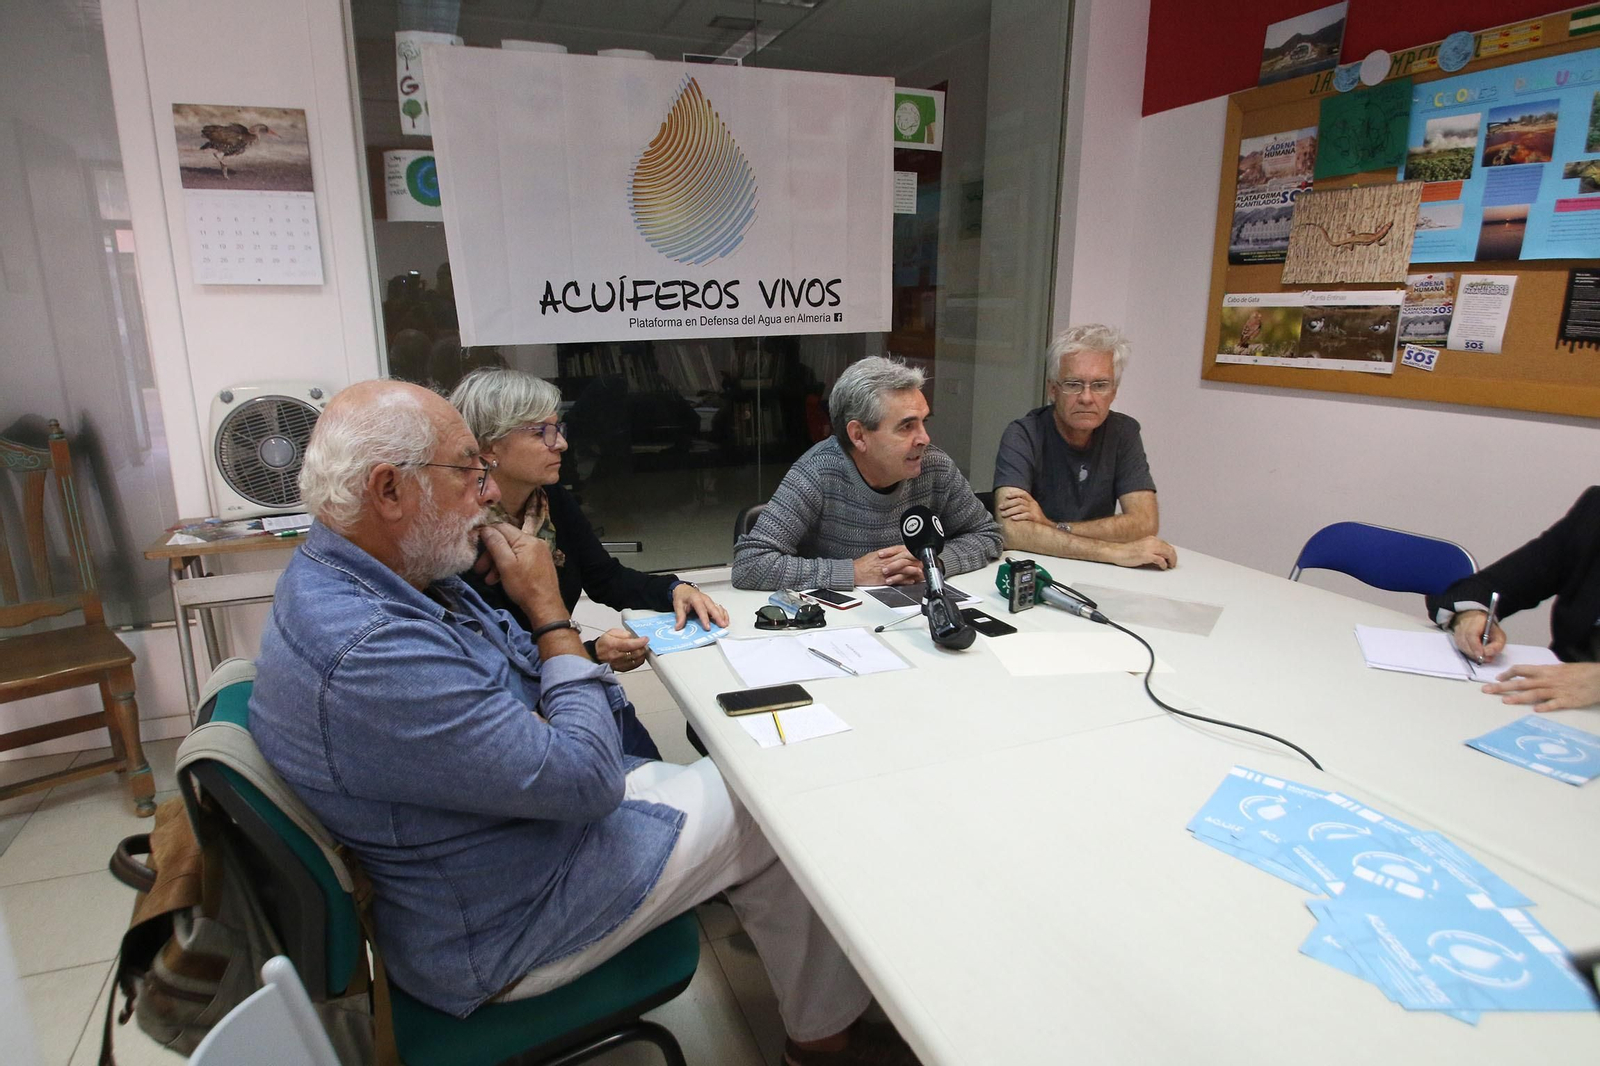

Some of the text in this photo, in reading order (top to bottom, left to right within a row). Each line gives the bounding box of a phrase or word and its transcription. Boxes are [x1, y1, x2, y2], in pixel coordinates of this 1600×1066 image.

[1265, 141, 1296, 152] CADENA
[1264, 147, 1296, 158] HUMANA
[1237, 191, 1281, 202] PLATAFORMA
[1280, 188, 1312, 204] SO
[1235, 198, 1280, 208] ACANTILADOS
[539, 275, 842, 316] ACUÍFEROS VIVOS
[1432, 306, 1452, 314] SOS
[629, 317, 683, 328] Plataforma
[685, 318, 697, 326] en
[700, 315, 739, 326] Defensa
[741, 314, 756, 325] del
[757, 314, 782, 327] Agua
[784, 315, 796, 323] en
[1404, 350, 1435, 365] SOS
